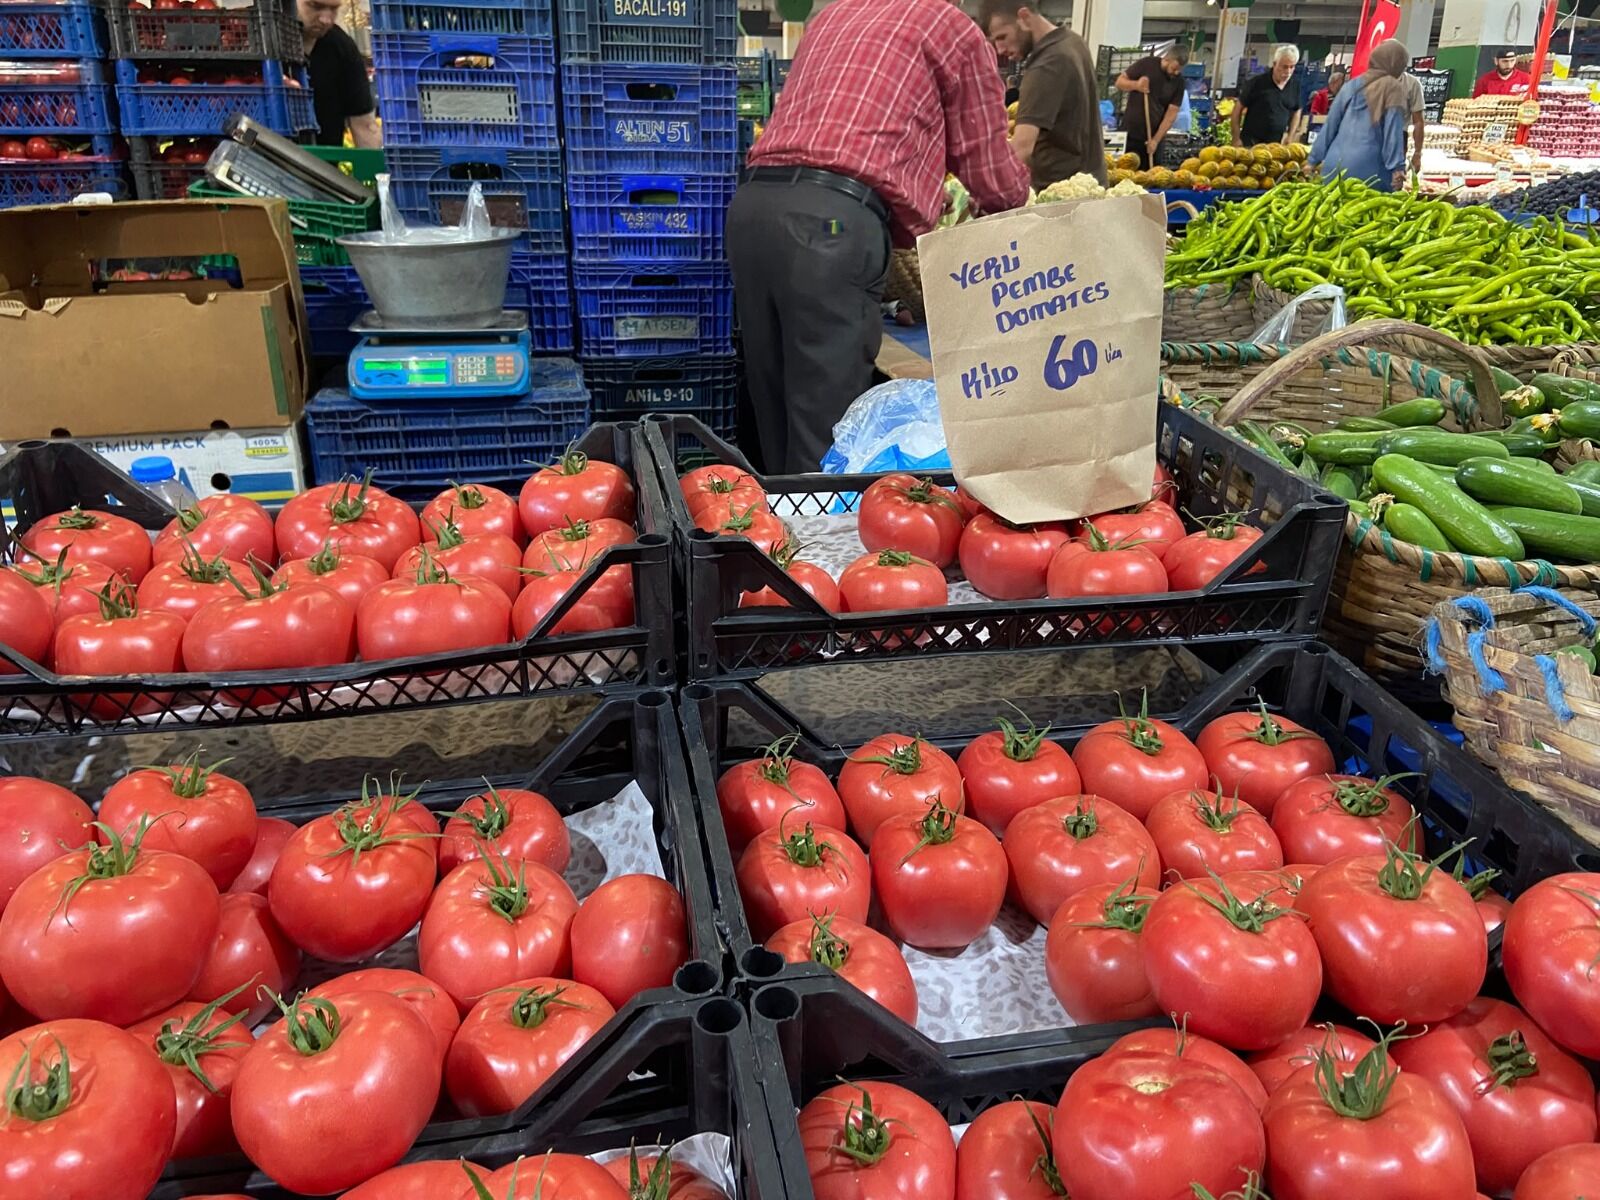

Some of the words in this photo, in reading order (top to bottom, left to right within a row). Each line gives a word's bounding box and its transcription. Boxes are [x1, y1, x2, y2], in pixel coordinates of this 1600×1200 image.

[667, 122, 690, 142] 51
[665, 212, 688, 229] 432
[992, 264, 1076, 308] PEMBE
[995, 282, 1109, 333] DOMATES
[1044, 335, 1098, 390] 60
[663, 387, 694, 402] 9-10
[161, 436, 206, 449] PACK
